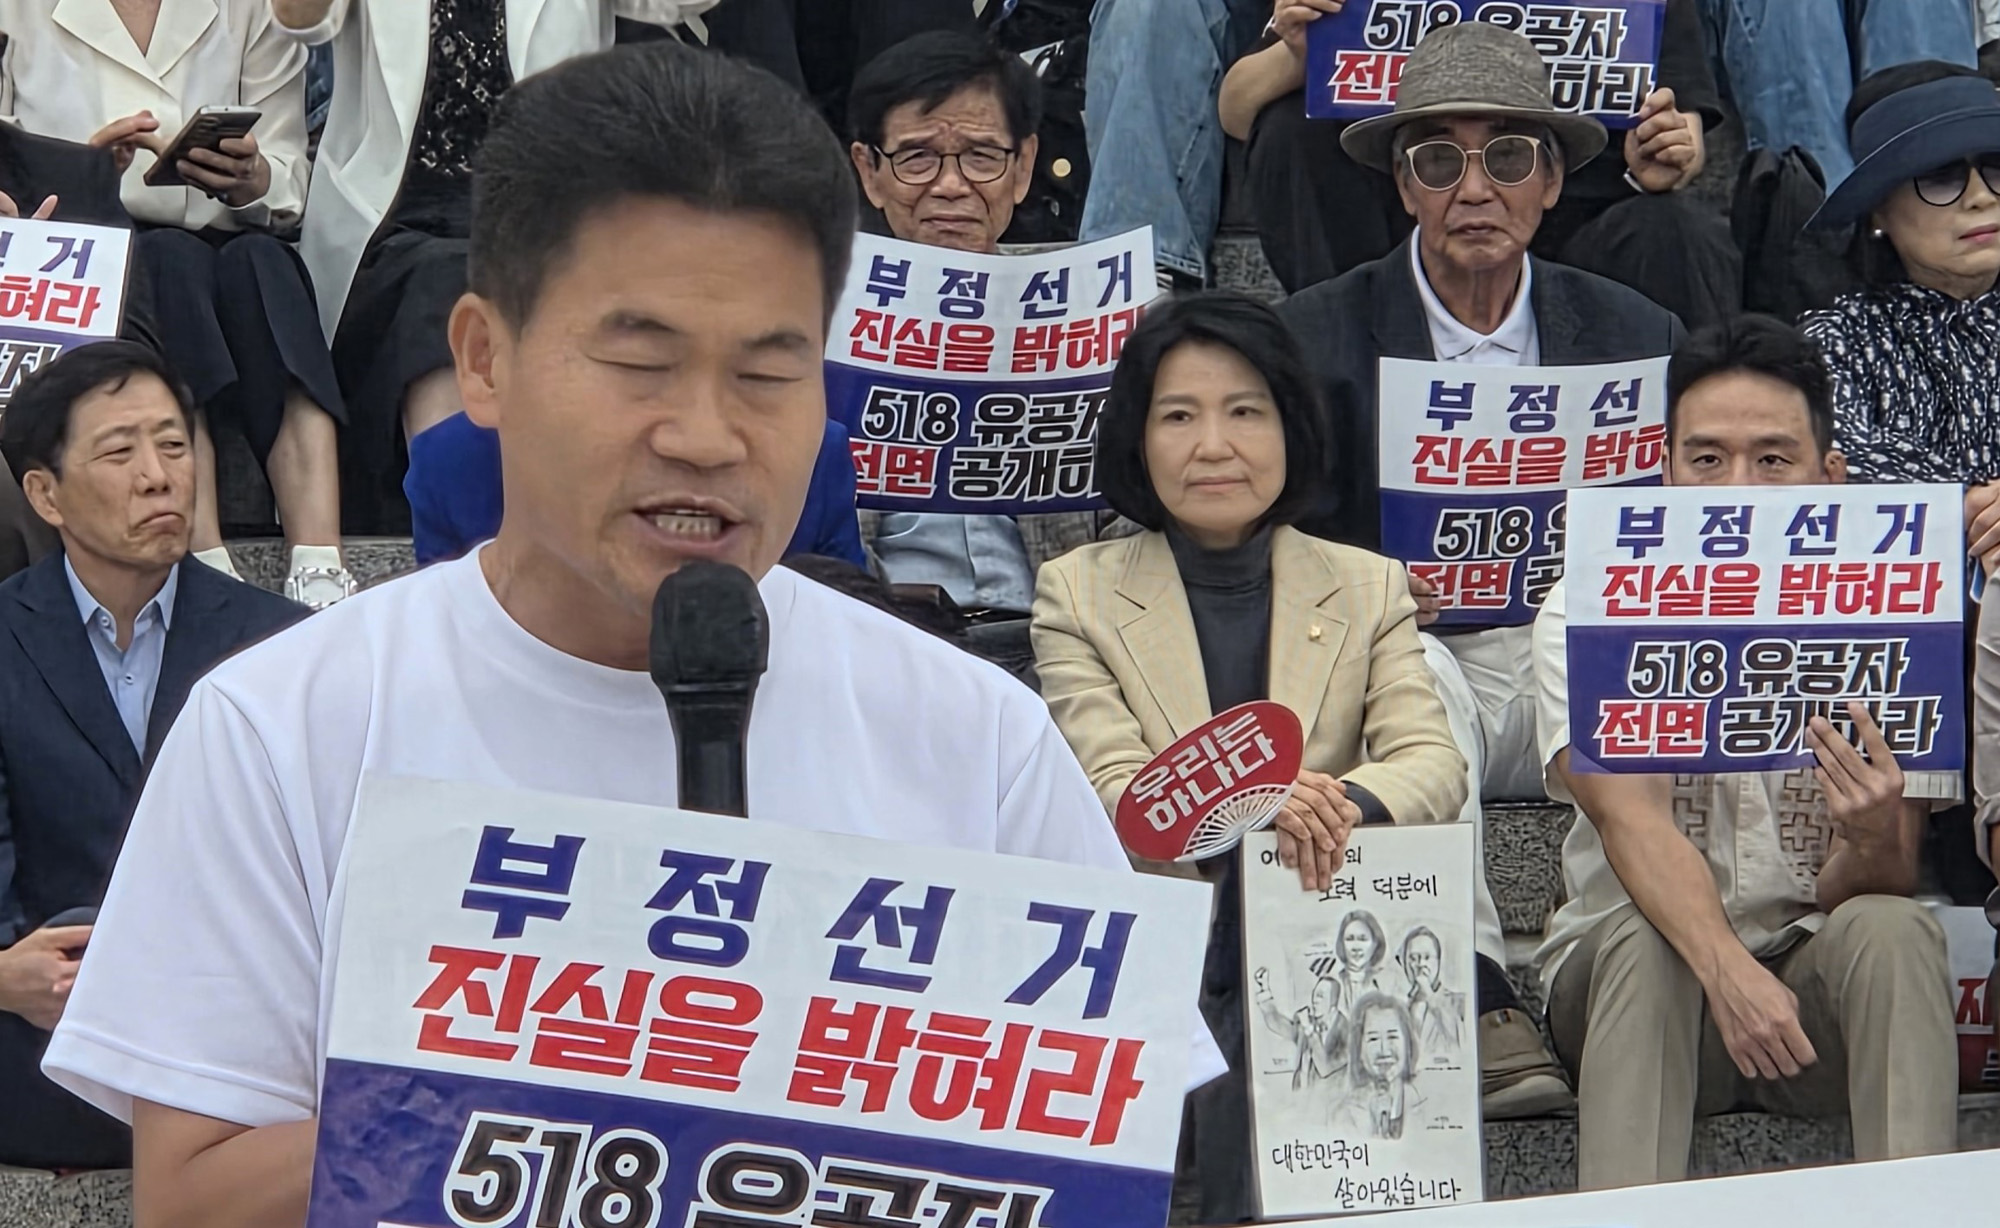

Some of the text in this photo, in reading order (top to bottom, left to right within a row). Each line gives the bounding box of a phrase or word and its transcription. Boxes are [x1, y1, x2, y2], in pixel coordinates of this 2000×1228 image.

[1327, 50, 1411, 104] 전
[850, 308, 995, 373] 진실을
[862, 386, 960, 444] 518
[1412, 435, 1567, 486] 진실을
[1433, 505, 1533, 561] 518
[1602, 563, 1760, 617] 진실을
[1778, 561, 1943, 616] 밝혀라
[1628, 637, 1910, 699] 518 유공자
[1593, 698, 1712, 758] 전면
[1131, 712, 1261, 803] 우리는
[1144, 732, 1276, 832] 하나다
[1373, 873, 1437, 901] 덕분에
[412, 944, 1145, 1147] 진실을 밝혀라
[443, 1111, 669, 1228] 518
[1272, 1138, 1369, 1172] 대한민국이
[1334, 1172, 1462, 1210] 살아있습니다
